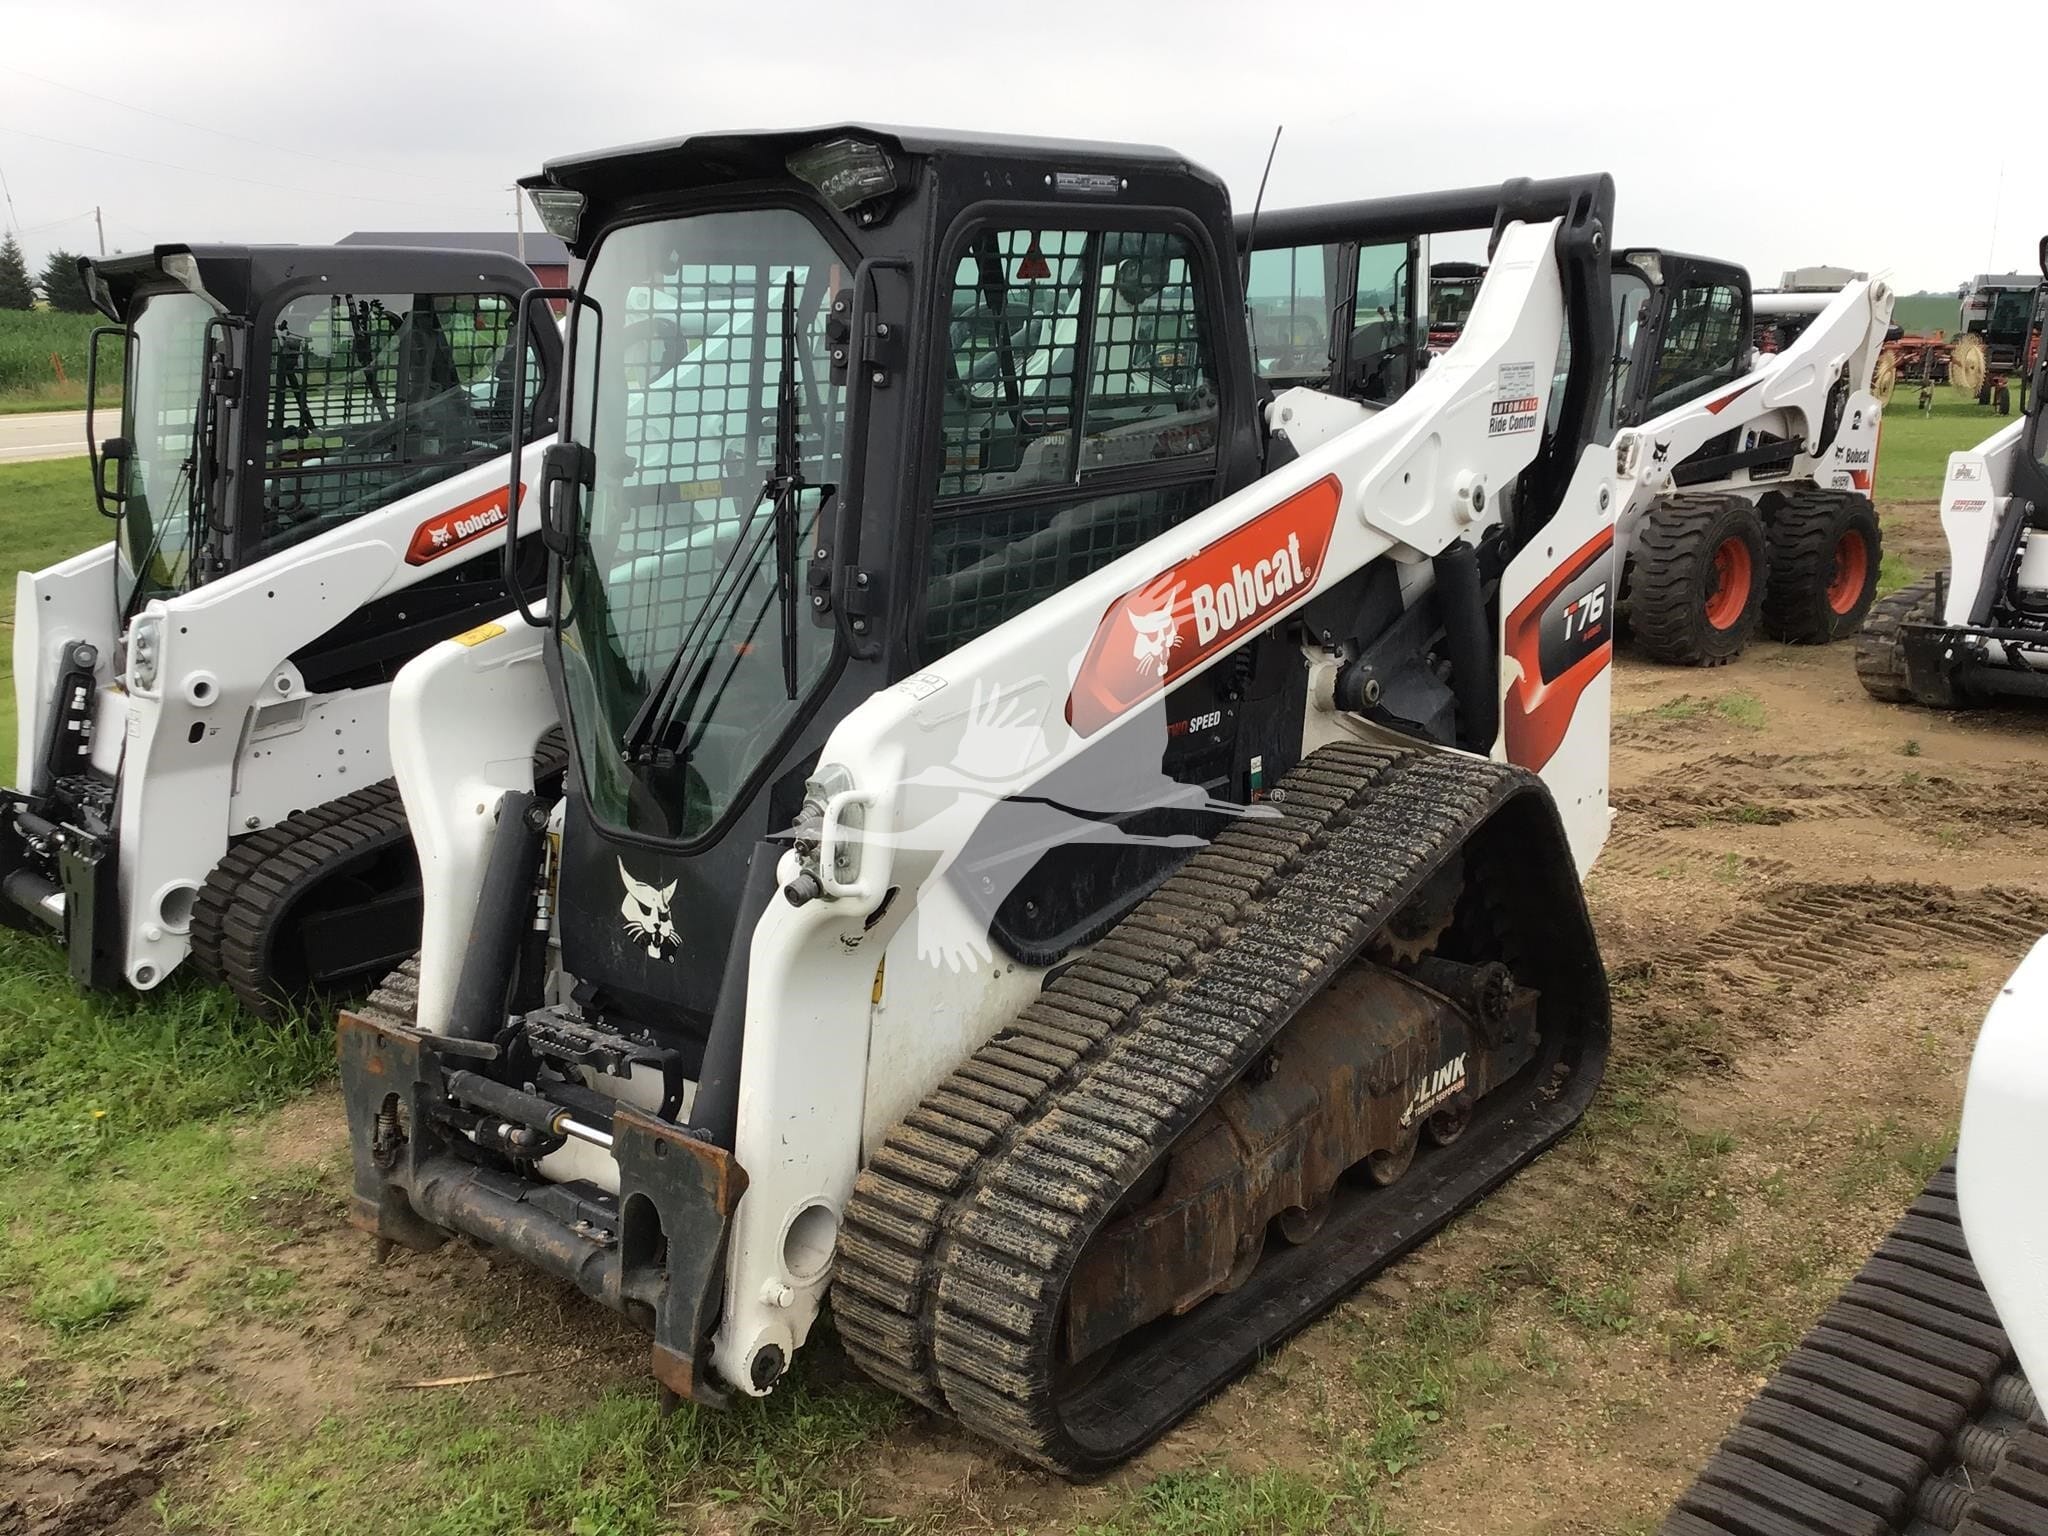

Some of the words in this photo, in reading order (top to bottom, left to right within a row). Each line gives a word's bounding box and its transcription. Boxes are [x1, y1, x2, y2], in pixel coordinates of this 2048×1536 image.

[1492, 399, 1537, 414] AUTOMATIC
[1488, 416, 1507, 433] Ride
[1508, 412, 1537, 431] Control
[1845, 447, 1870, 463] Bobcat
[453, 503, 504, 539] Bobcat
[1191, 531, 1305, 647] Bobcat
[1563, 582, 1607, 641] T76
[1189, 710, 1221, 733] SPEED
